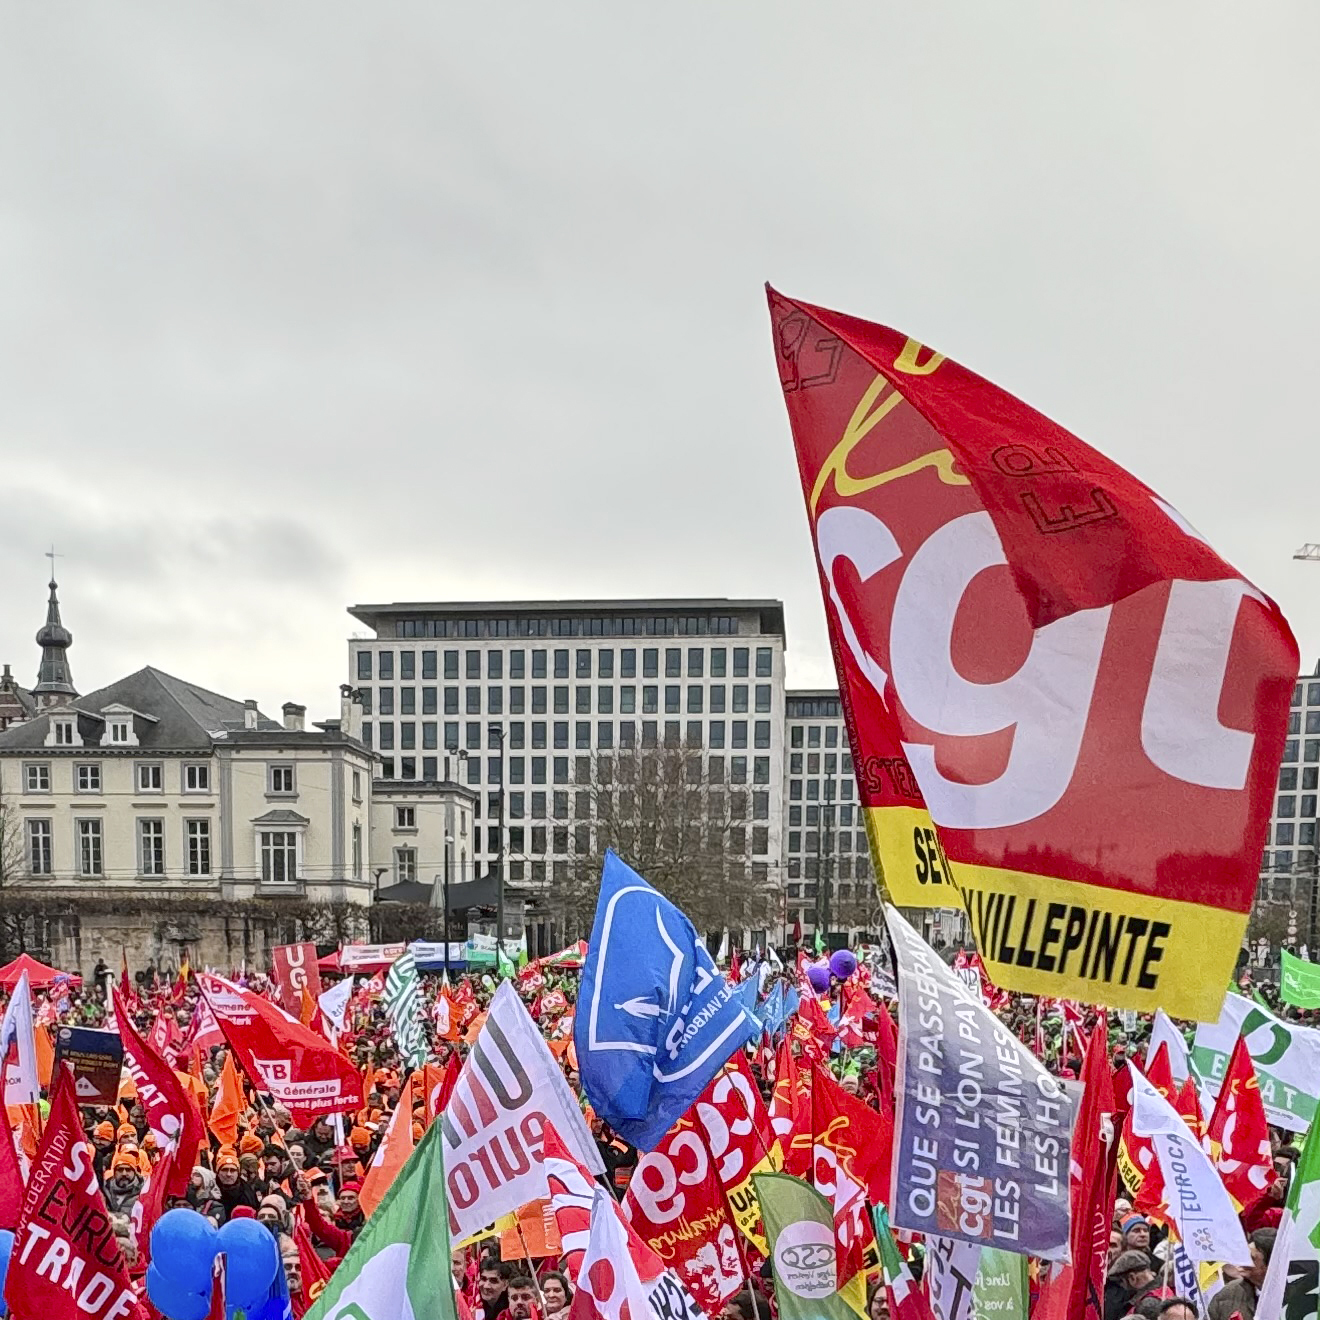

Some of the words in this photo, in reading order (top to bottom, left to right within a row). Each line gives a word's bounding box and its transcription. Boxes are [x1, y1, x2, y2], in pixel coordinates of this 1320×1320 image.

[977, 890, 1171, 989] VILLEPINTE
[915, 1083, 941, 1131] SE
[956, 1048, 984, 1130] L'ON
[995, 1029, 1022, 1169] FEMMES
[910, 1135, 938, 1217] QUE
[954, 1140, 981, 1171] SI
[1034, 1134, 1060, 1195] LES
[959, 1174, 993, 1237] cgt
[993, 1177, 1021, 1241] LES
